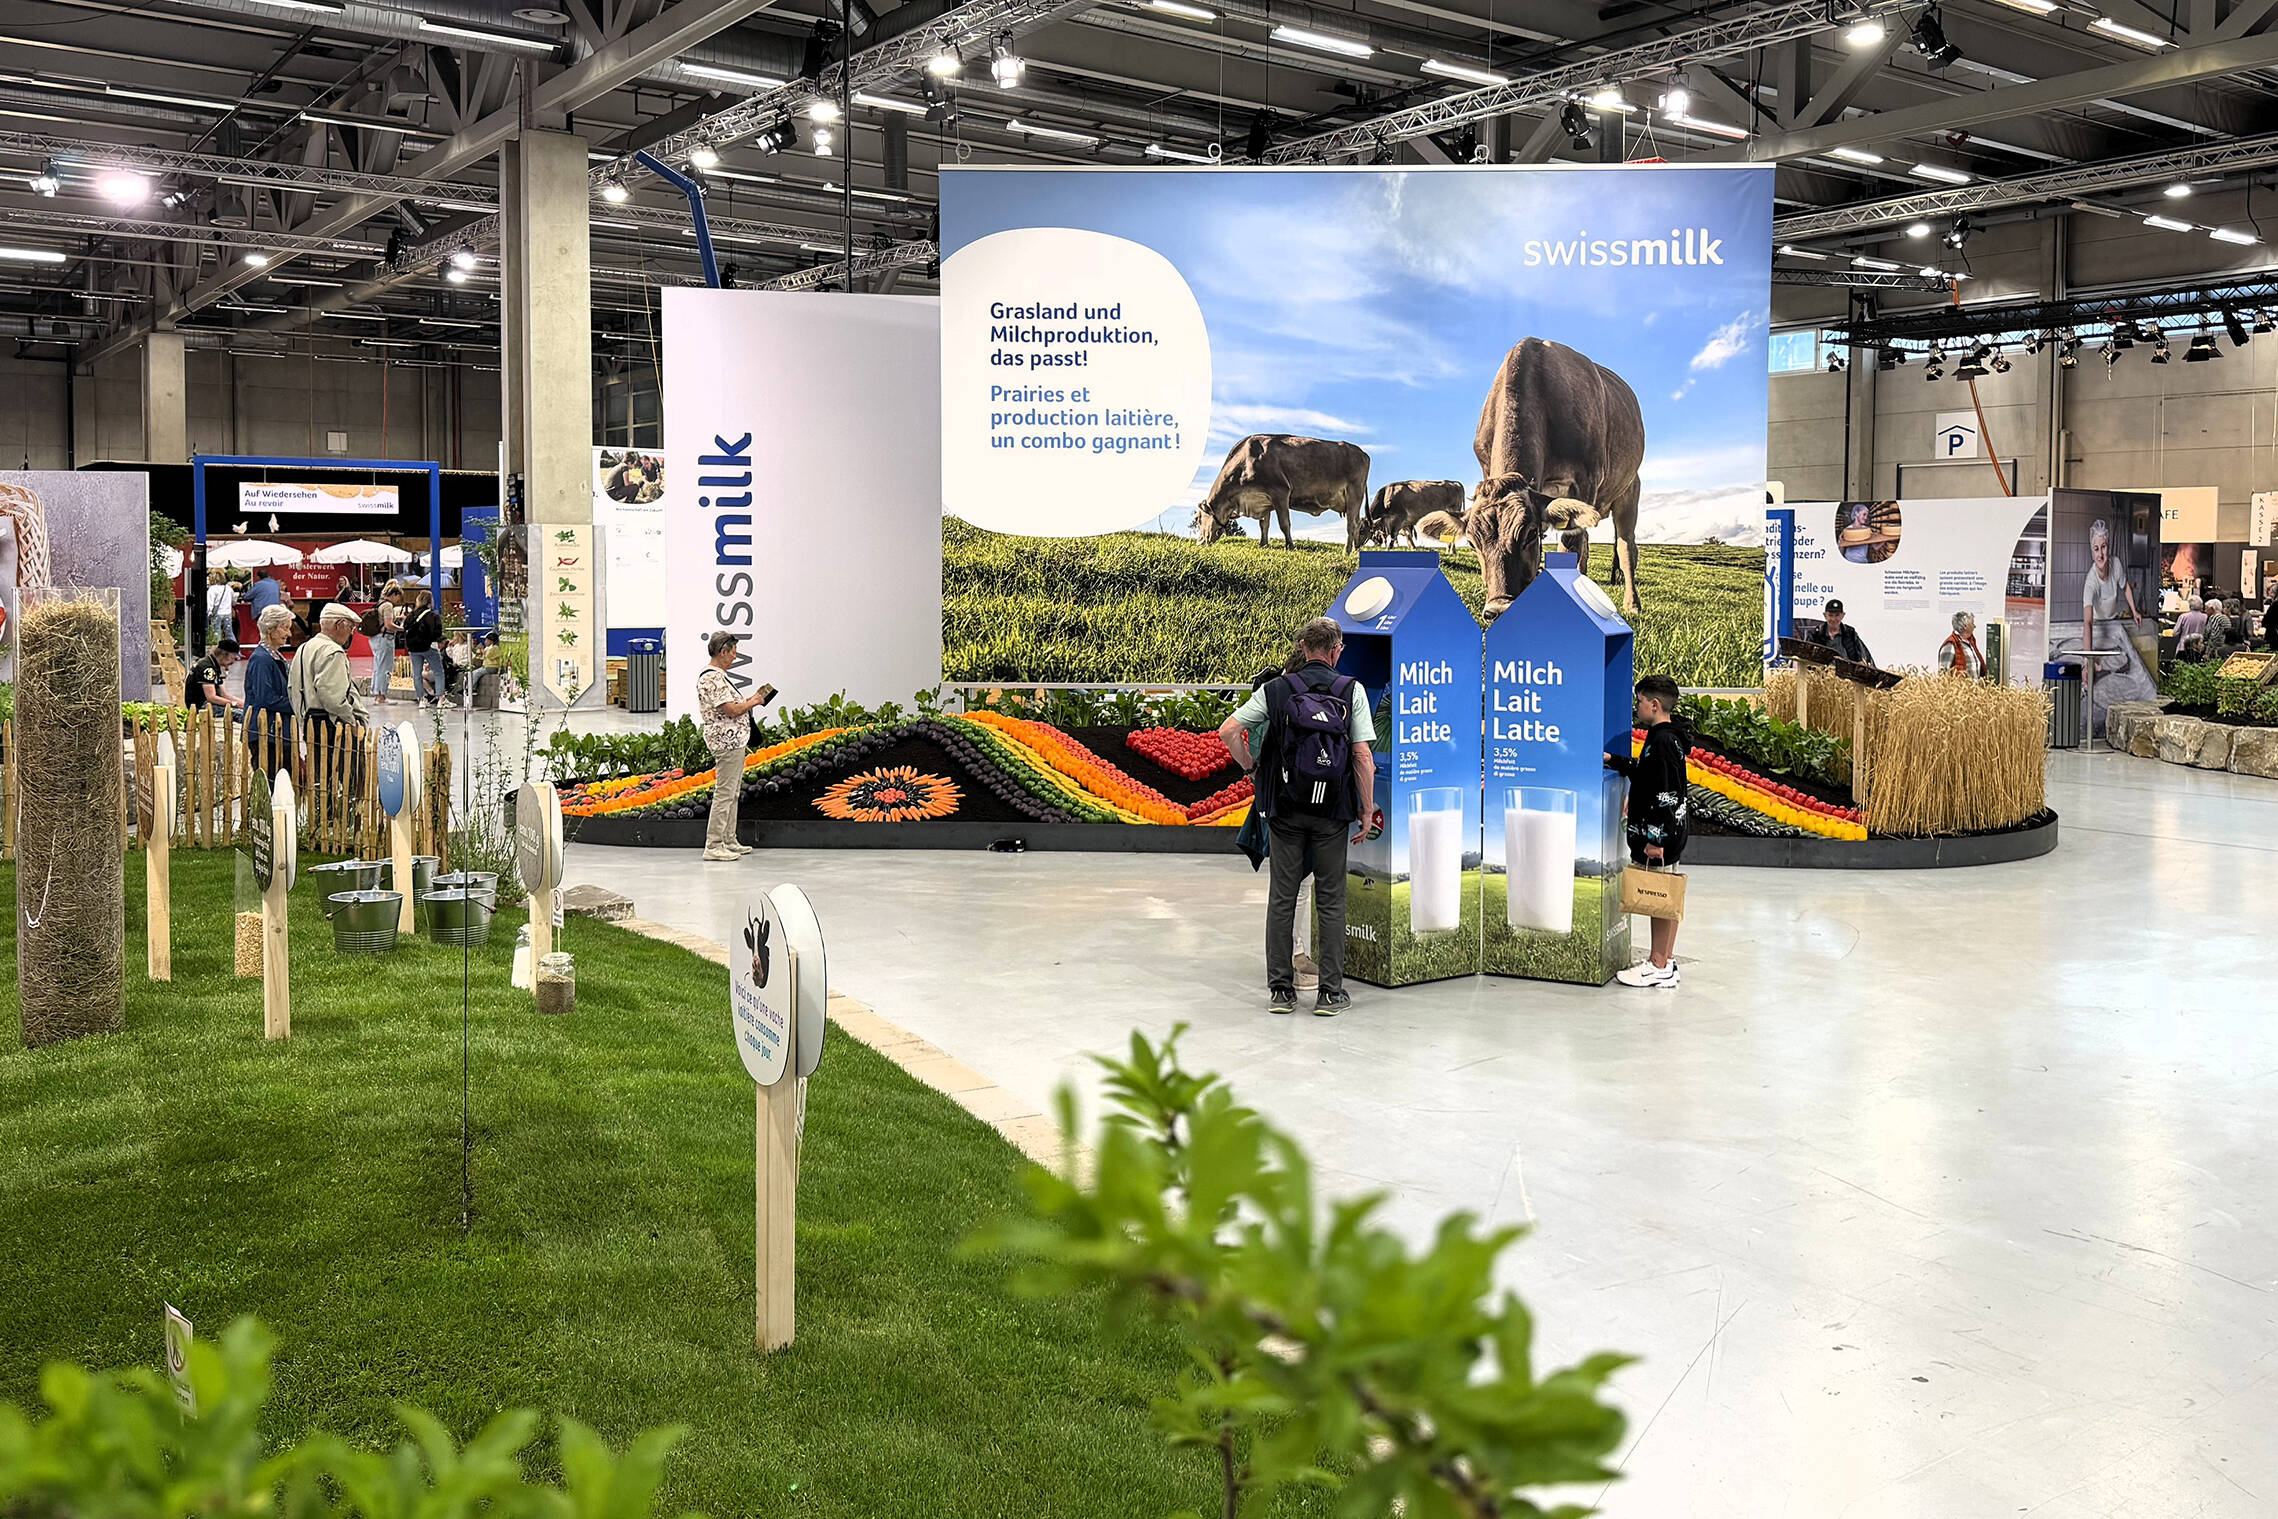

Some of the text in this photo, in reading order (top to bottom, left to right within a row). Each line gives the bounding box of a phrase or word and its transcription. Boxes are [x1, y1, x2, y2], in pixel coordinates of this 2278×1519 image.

[1523, 228, 1724, 266] swissmilk
[990, 302, 1121, 320] Grasland und
[990, 325, 1158, 347] Milchproduktion,
[990, 348, 1088, 371] das passt!
[990, 385, 1090, 402] Prairies et
[990, 408, 1179, 429] production laitière,
[991, 435, 1014, 448] un
[1021, 432, 1086, 449] combo
[1948, 434, 1964, 456] P
[244, 489, 318, 499] Auf Wiedersehen
[244, 499, 284, 508] Au revoir
[1794, 536, 1815, 546] oder
[698, 432, 754, 690] wissmilk
[1794, 582, 1834, 593] nelle ou
[1400, 660, 1453, 686] Milch
[1493, 660, 1563, 685] Milch
[1400, 690, 1438, 715] Lait
[1494, 689, 1542, 713] Lait
[1400, 720, 1451, 744] Latte
[1493, 717, 1560, 742] Latte
[1400, 751, 1418, 762] 3,5%
[1493, 747, 1518, 758] 3,5%
[1345, 924, 1377, 942] smilk
[735, 979, 746, 1000] Voici
[747, 992, 752, 1004] ce
[769, 1008, 784, 1029] vache
[755, 1019, 780, 1047] consomme
